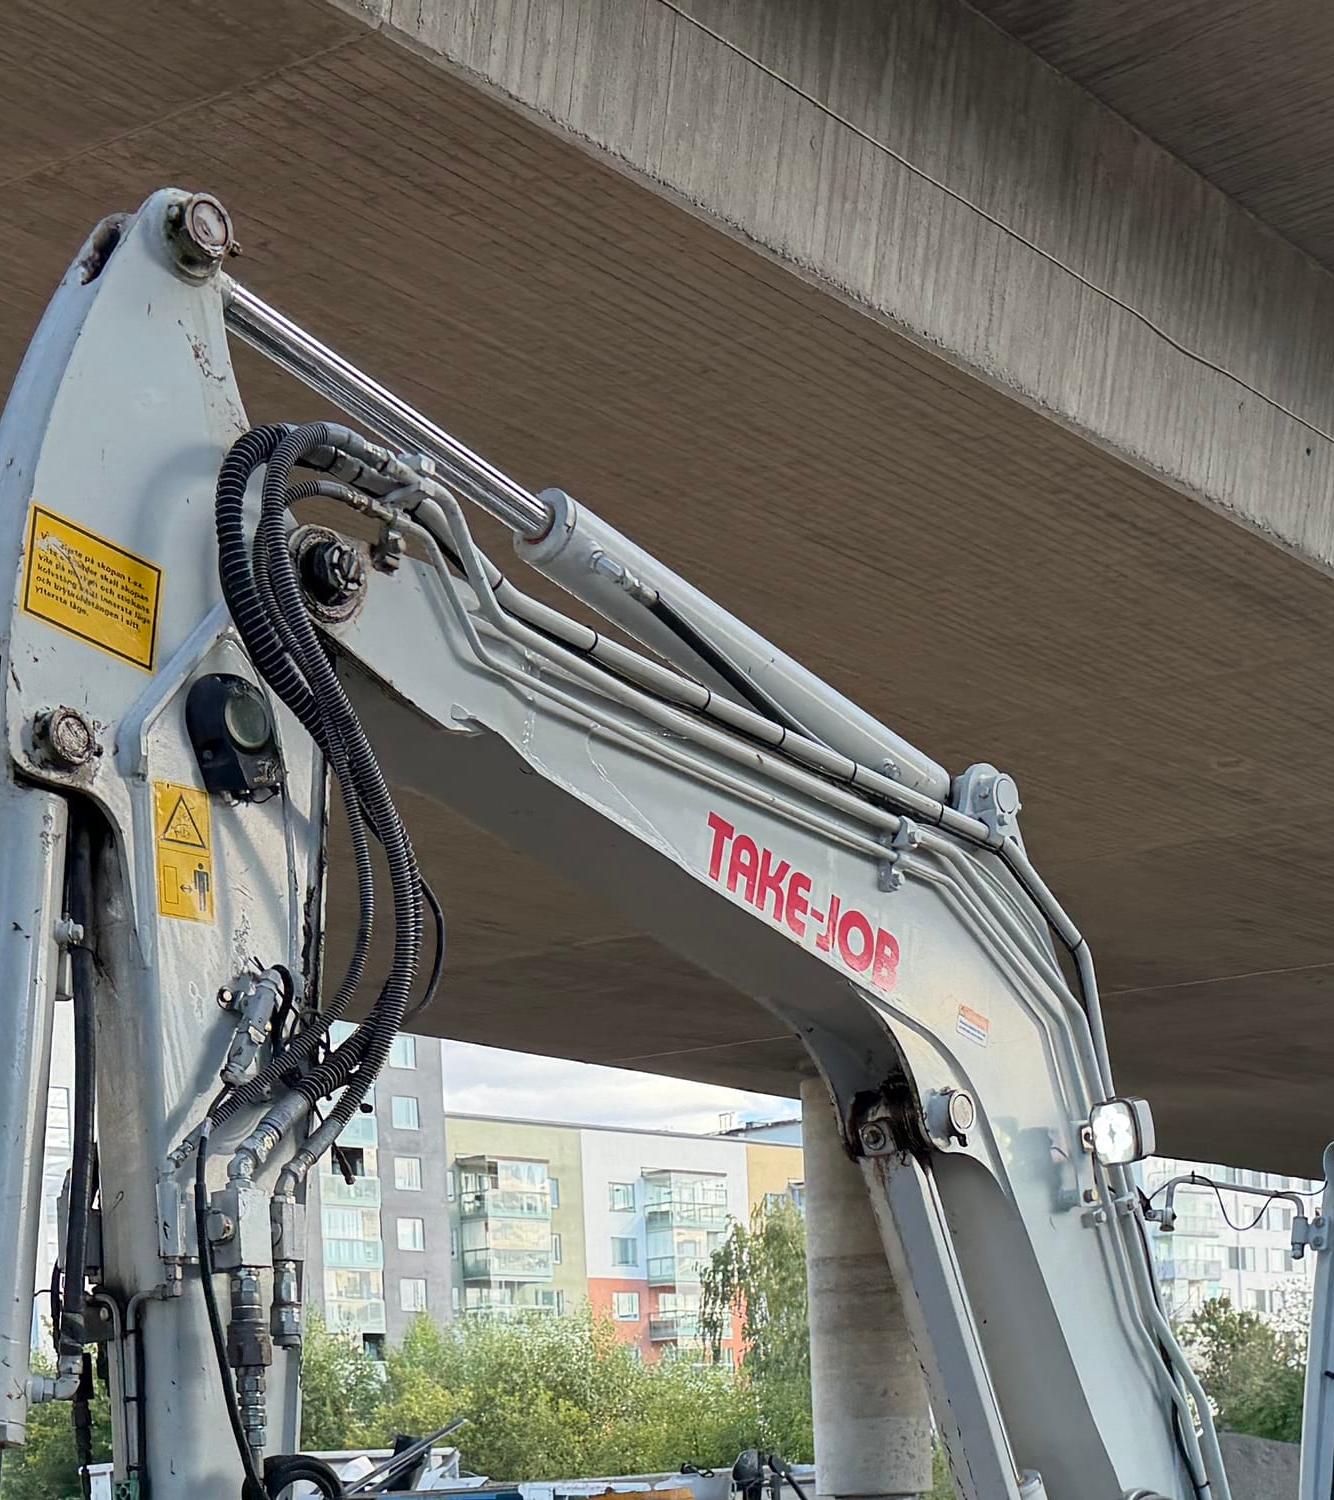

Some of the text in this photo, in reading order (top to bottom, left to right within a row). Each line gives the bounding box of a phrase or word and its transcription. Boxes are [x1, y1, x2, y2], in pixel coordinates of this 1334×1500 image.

[97, 562, 125, 580] skopan
[121, 584, 149, 603] skopan
[707, 811, 900, 993] TAKE-JOB
